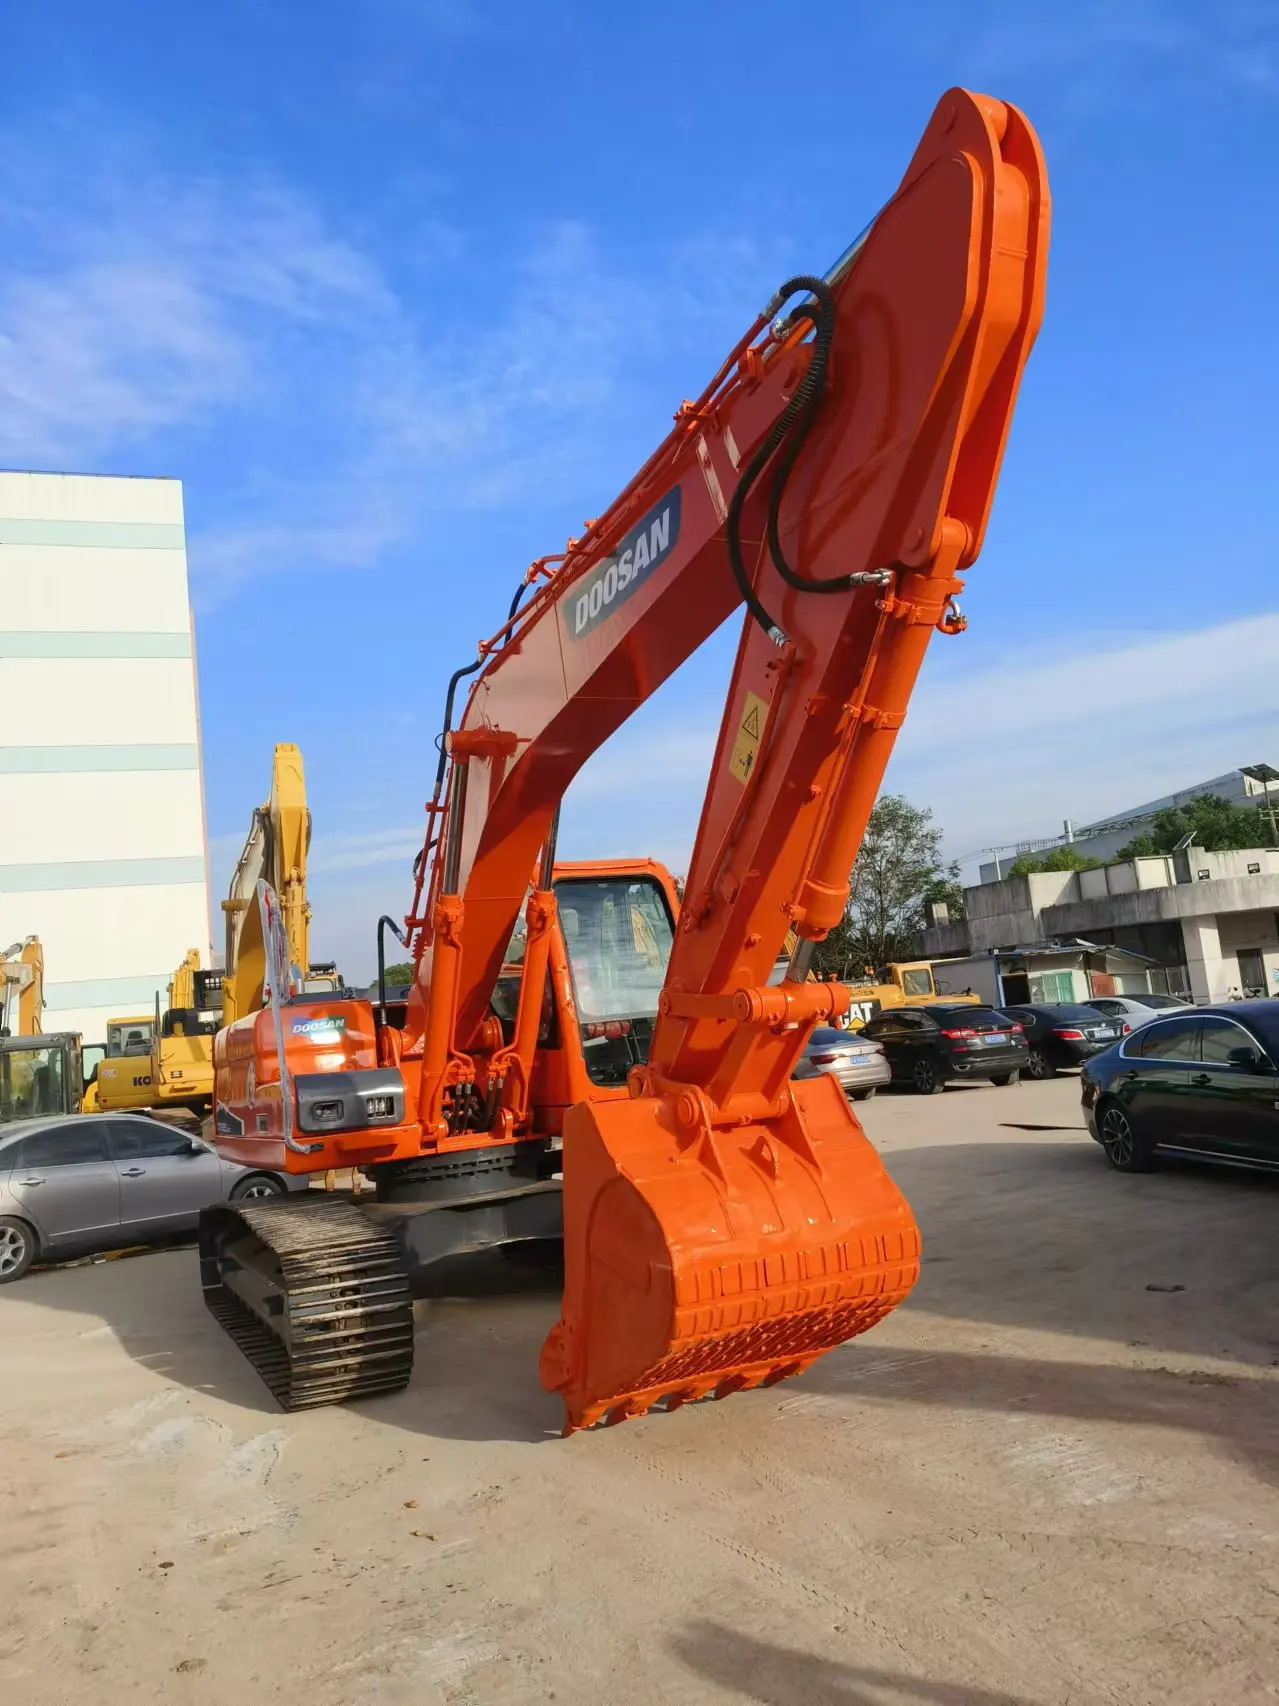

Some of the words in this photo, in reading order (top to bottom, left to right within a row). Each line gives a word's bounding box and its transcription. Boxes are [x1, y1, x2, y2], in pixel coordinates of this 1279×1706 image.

[574, 507, 671, 635] DOOSAN
[292, 1017, 345, 1034] DOOSAN
[839, 1001, 873, 1030] CAT
